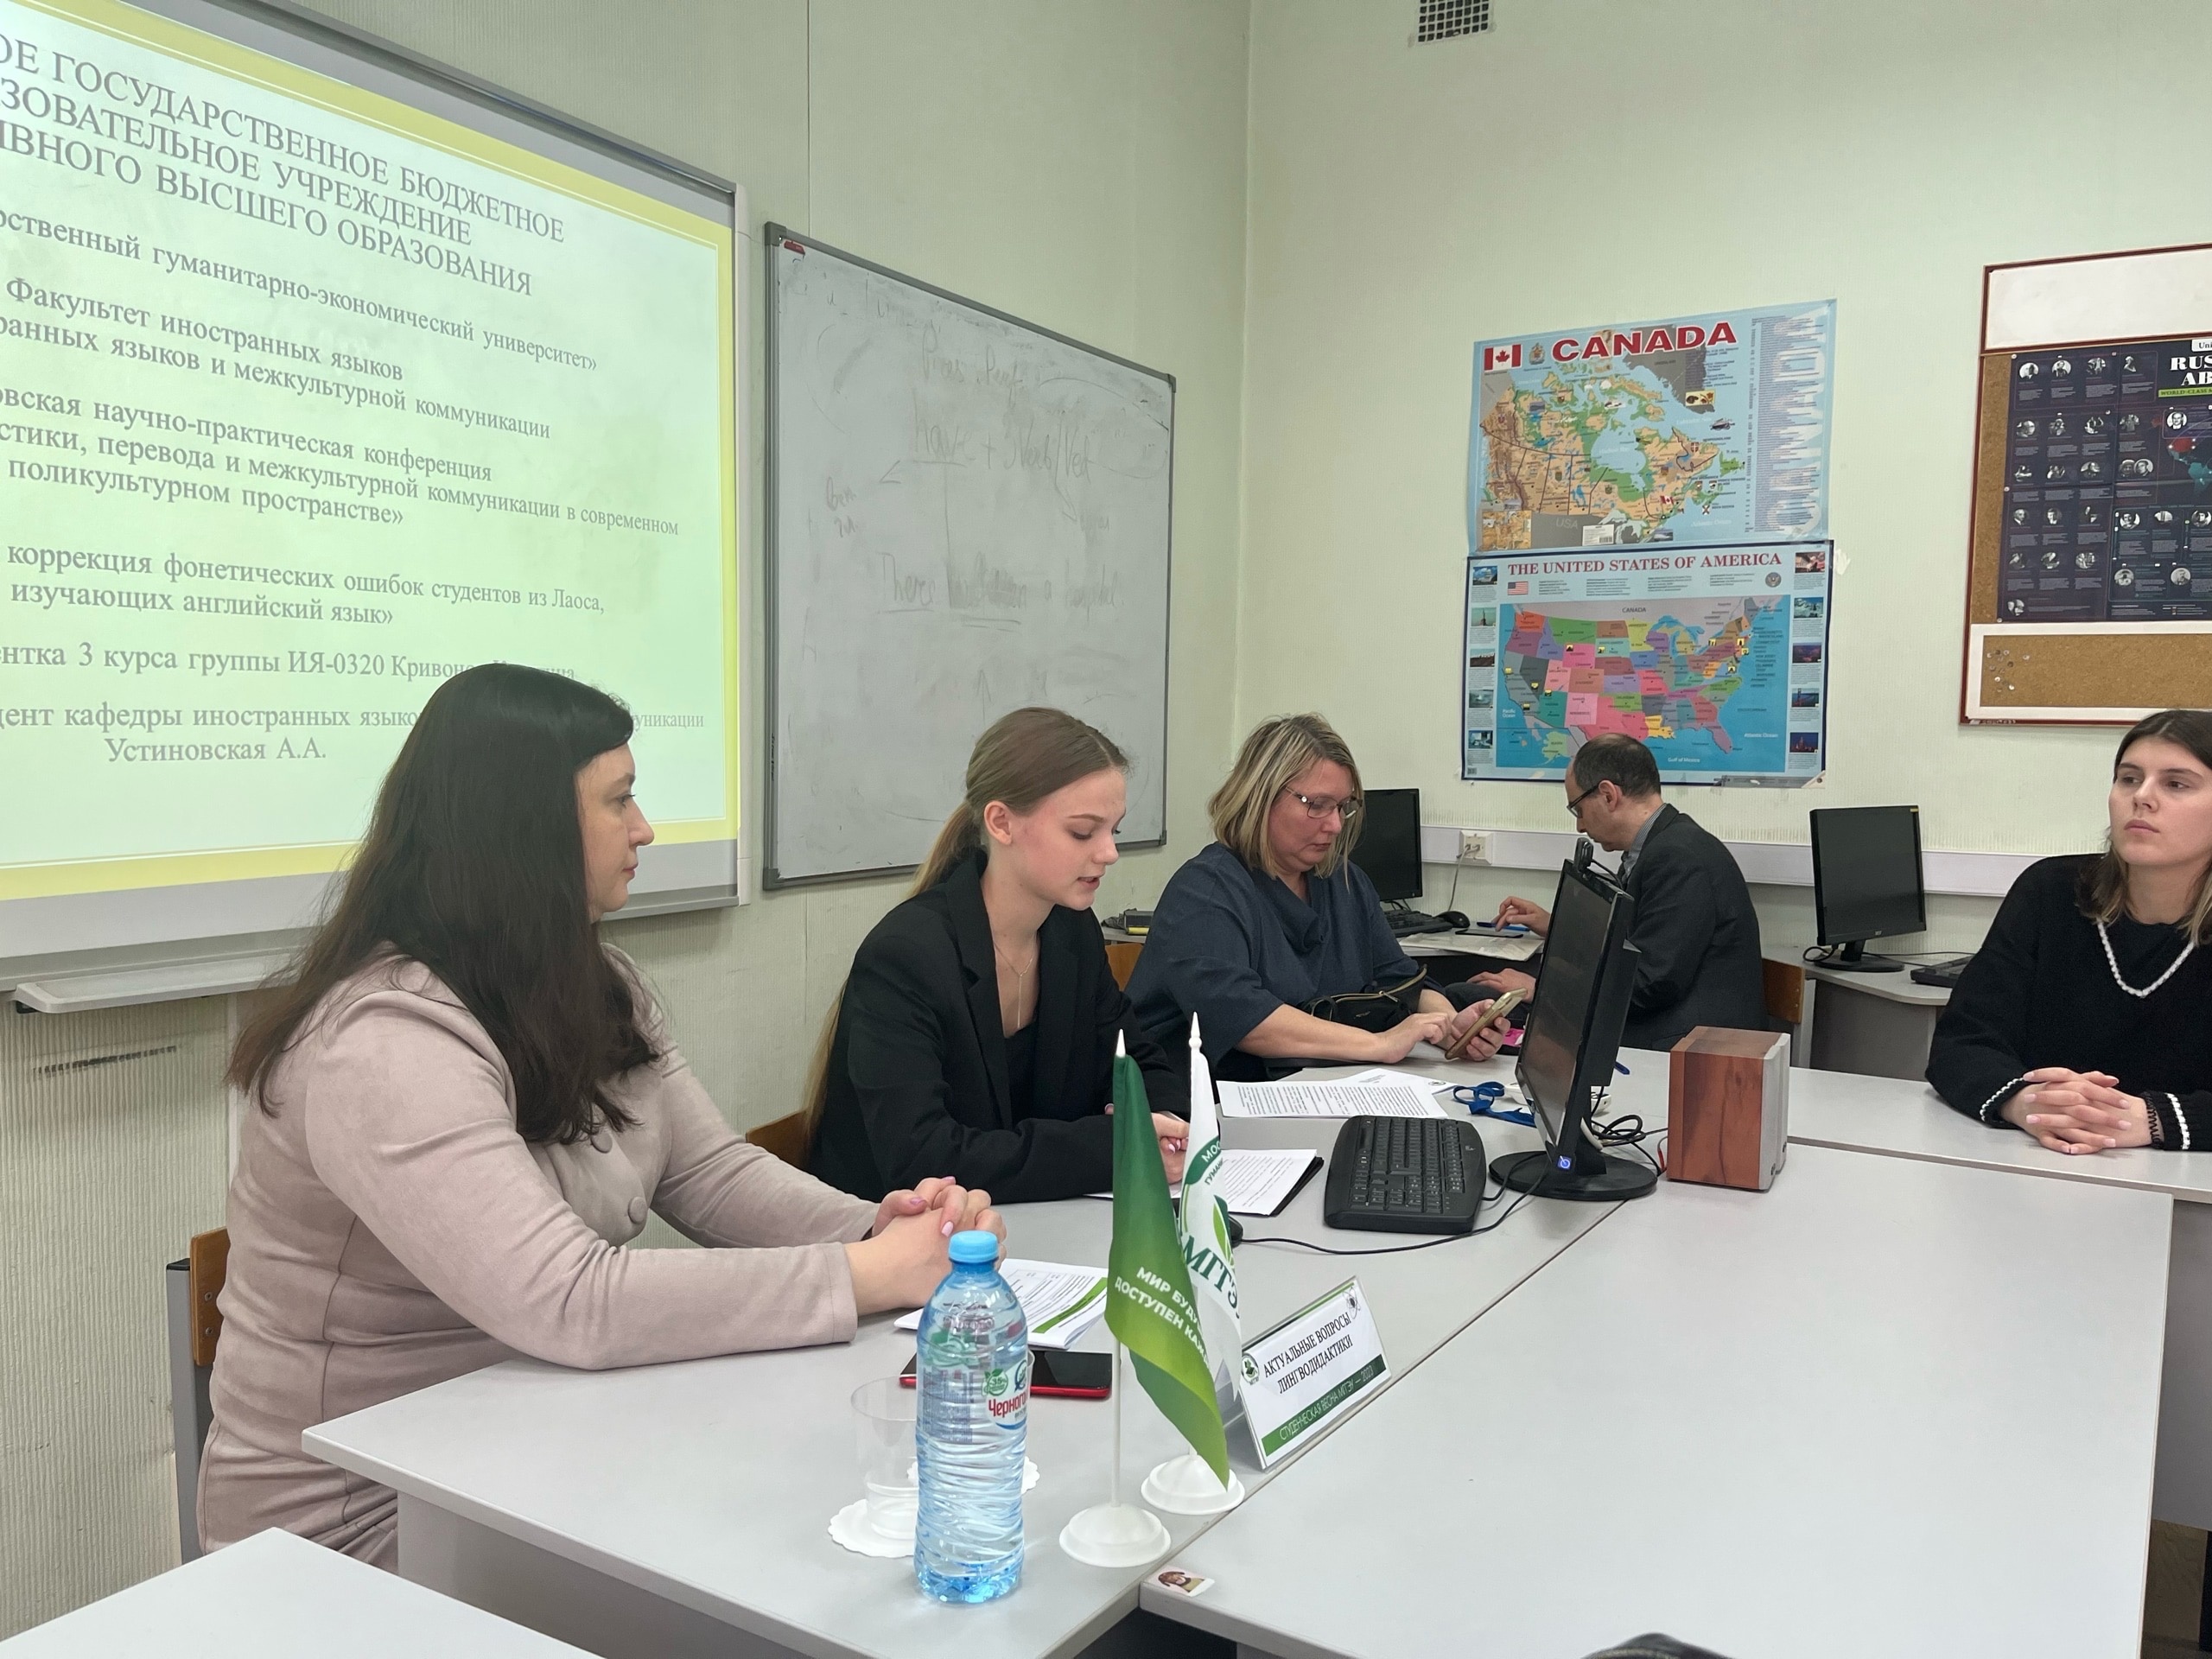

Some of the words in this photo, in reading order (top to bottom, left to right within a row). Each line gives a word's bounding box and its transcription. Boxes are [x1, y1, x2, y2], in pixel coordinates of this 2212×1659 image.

[1, 78, 261, 182] ЗОВАТЕЛЬНОЕ
[272, 161, 472, 245] УЧРЕЖДЕНИЕ
[52, 51, 389, 185] ГОСУДАРСТВЕННОЕ
[400, 166, 565, 243] БЮДЖЕТНОЕ
[0, 119, 142, 184] ВНОГО
[156, 164, 327, 238] ВЫСШЕГО
[338, 219, 532, 296] ОБРАЗОВАНИЯ
[6, 277, 150, 327] Факультет
[161, 315, 321, 364] иностранных
[331, 351, 403, 381] языков
[152, 245, 474, 341] гуманитарно-экономический
[483, 330, 597, 372] университет»
[1551, 321, 1738, 363] CANADA
[111, 338, 200, 370] языков
[212, 358, 226, 375] и
[235, 359, 406, 411] межкультурной
[416, 397, 550, 438] коммуникации
[0, 388, 81, 416] вская
[94, 402, 354, 461] научно-практическая
[365, 446, 492, 481] конференция
[9, 459, 230, 503] поликультурном
[242, 489, 404, 525] пространстве»
[99, 437, 215, 470] перевода
[227, 454, 240, 472] и
[249, 458, 418, 499] межкультурной
[428, 483, 560, 518] коммуникации
[568, 506, 576, 519] в
[581, 510, 679, 536] современном
[1556, 518, 1578, 529] USA
[8, 545, 152, 575] коррекция
[164, 552, 334, 589] фонетических
[344, 574, 423, 596] ошибок
[432, 582, 521, 604] студентов
[529, 592, 547, 606] из
[552, 588, 605, 614] Лаоса,
[1508, 563, 1539, 575] THE
[1542, 560, 1605, 575] UNITED
[1609, 557, 1670, 572] STATES
[1674, 556, 1695, 569] OF
[1700, 553, 1782, 568] AMERICA
[11, 583, 174, 611] изучающих
[183, 594, 323, 620] английский
[331, 606, 393, 625] язык»
[0, 646, 66, 665] нтка
[79, 642, 92, 666] 3
[104, 650, 177, 674] курса
[188, 652, 280, 677] группы
[288, 651, 385, 676] ИЯ-0320
[0, 709, 54, 730] ент
[65, 702, 182, 733] кафедры
[193, 708, 351, 732] иностранных
[359, 711, 420, 727] языко
[632, 714, 704, 732] уникации
[105, 738, 266, 763] Устиновская
[276, 737, 327, 760] А.А.
[1115, 1276, 1184, 1329] ДОСТУПЕН
[1136, 1267, 1171, 1293] МИР
[1181, 1235, 1239, 1319] МГГЭ
[1263, 1334, 1319, 1377] АКТУАЛЬНЫЕ
[1315, 1312, 1351, 1344] ВОПРОСЫ
[1277, 1334, 1353, 1394] ЛИНГВОДИДАКТИКИ
[1279, 1403, 1322, 1440] СТУДЕНЧЕСКАЯ
[1360, 1364, 1374, 1381] 2023
